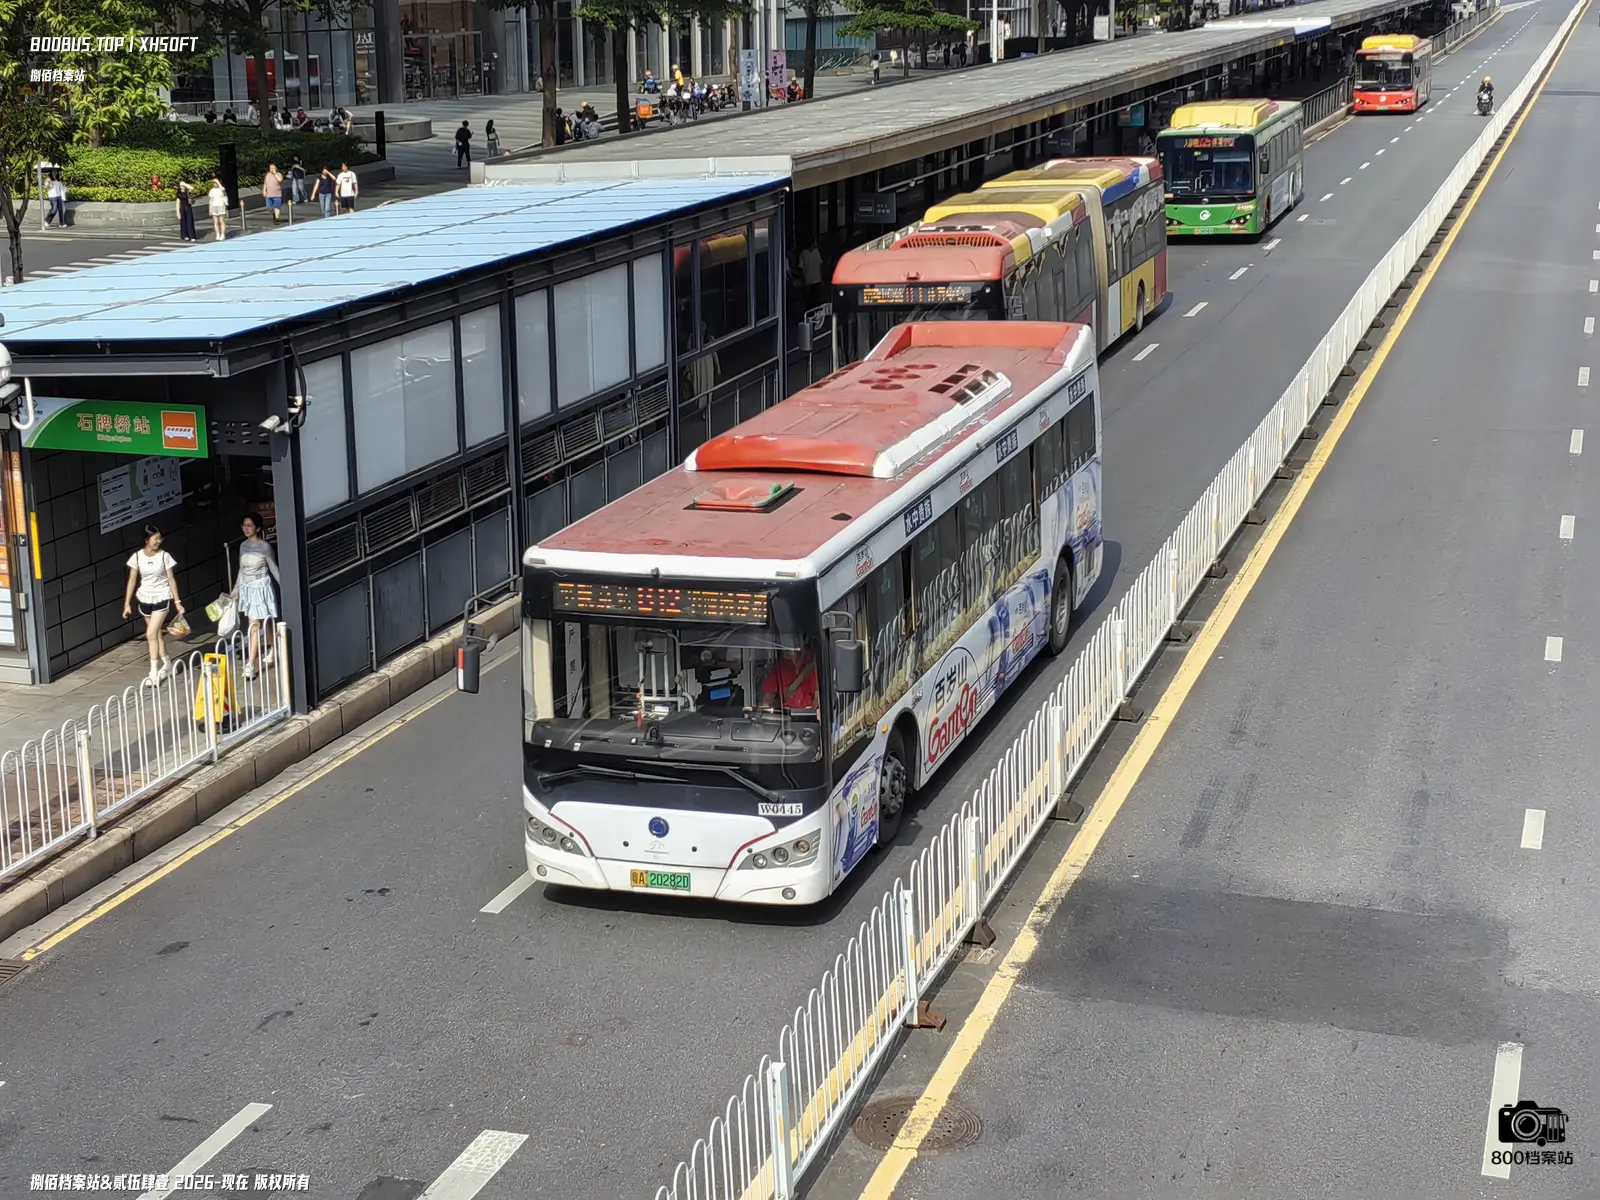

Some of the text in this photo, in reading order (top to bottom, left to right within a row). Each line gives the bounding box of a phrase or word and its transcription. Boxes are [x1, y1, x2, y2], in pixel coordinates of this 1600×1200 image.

[76, 412, 151, 435] 石牌桥站
[905, 499, 932, 533] 水中贵族
[935, 655, 968, 715] 百岁山
